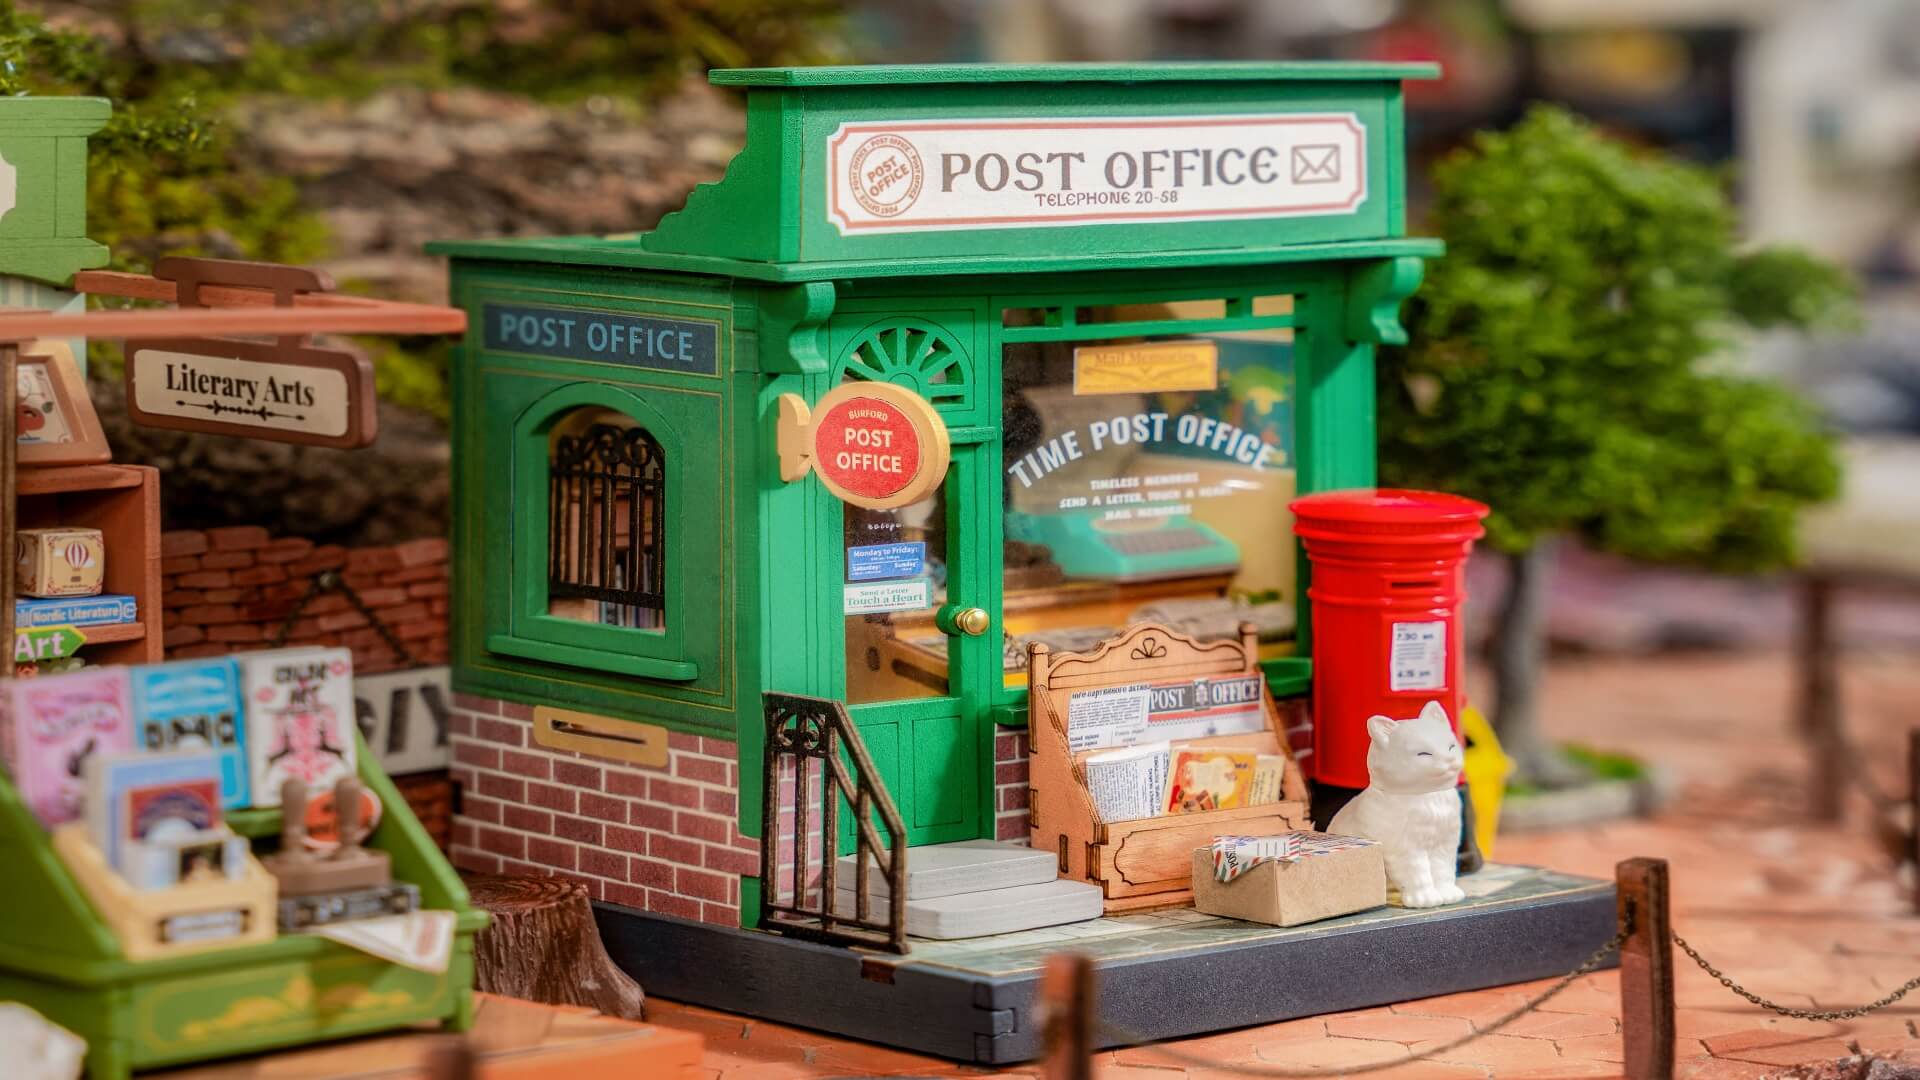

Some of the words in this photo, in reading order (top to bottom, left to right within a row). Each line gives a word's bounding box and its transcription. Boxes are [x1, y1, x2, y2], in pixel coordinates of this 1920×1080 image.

[867, 155, 897, 182] POST
[869, 163, 909, 197] OFFICE
[940, 151, 1085, 193] POST
[1103, 146, 1279, 190] OFFICE
[1034, 192, 1131, 207] TELEPHONE
[1135, 190, 1179, 204] 20-58
[501, 314, 576, 348] POST
[587, 322, 694, 362] OFFICE
[165, 363, 259, 405] Literary
[264, 376, 315, 407] Arts
[848, 409, 888, 422] BURFORD
[845, 428, 894, 448] POST
[836, 452, 902, 473] OFFICE
[1008, 430, 1083, 488] TIME
[1089, 413, 1168, 451] POST
[1177, 414, 1277, 470] OFFICE
[1059, 497, 1087, 508] SEND
[1092, 496, 1102, 505] A
[854, 549, 881, 557] Monday
[848, 596, 880, 606] Touch
[893, 594, 922, 603] Heart
[32, 609, 66, 622] Nordic
[68, 605, 121, 620] Literature
[15, 632, 65, 660] Art
[1150, 686, 1186, 710] POST
[1212, 679, 1259, 704] OFFICE
